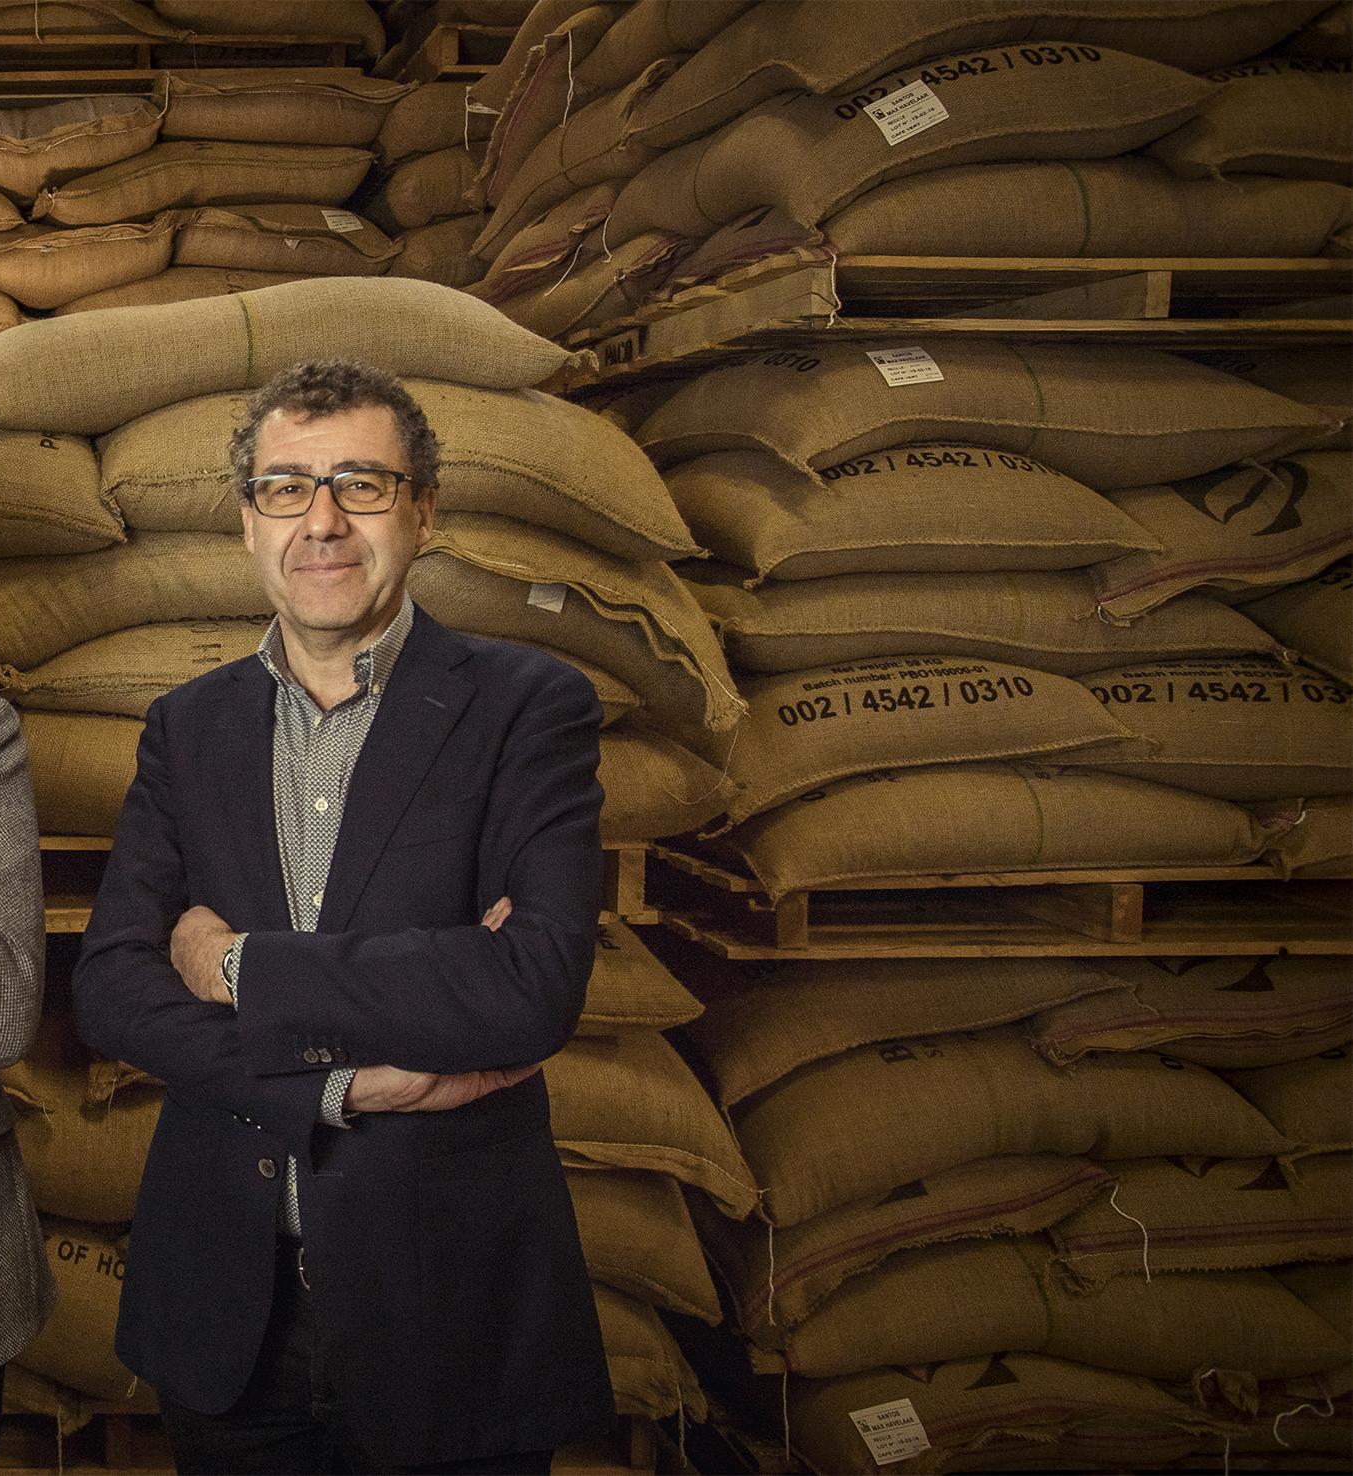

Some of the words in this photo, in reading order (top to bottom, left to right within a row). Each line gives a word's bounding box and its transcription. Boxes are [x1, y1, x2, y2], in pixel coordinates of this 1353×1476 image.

[919, 56, 998, 86] 4542
[1020, 46, 1101, 66] 0310
[886, 107, 900, 116] MAX
[899, 92, 929, 110] HAVELAAR
[891, 92, 914, 106] SANTOS
[907, 122, 921, 132] VERT
[905, 452, 979, 468] 4542
[831, 665, 855, 675] Net
[856, 660, 901, 674] weight:
[802, 675, 842, 692] Batch
[843, 672, 897, 686] number:
[778, 696, 837, 726] 002
[861, 685, 936, 713] 4542
[959, 676, 1034, 705] 0310
[1091, 683, 1156, 705] 002
[1188, 682, 1271, 703] 4542
[58, 1240, 89, 1265] OF
[871, 1423, 885, 1431] MAX
[885, 1416, 915, 1428] HAVELAAR
[877, 1410, 901, 1420] SANTOS
